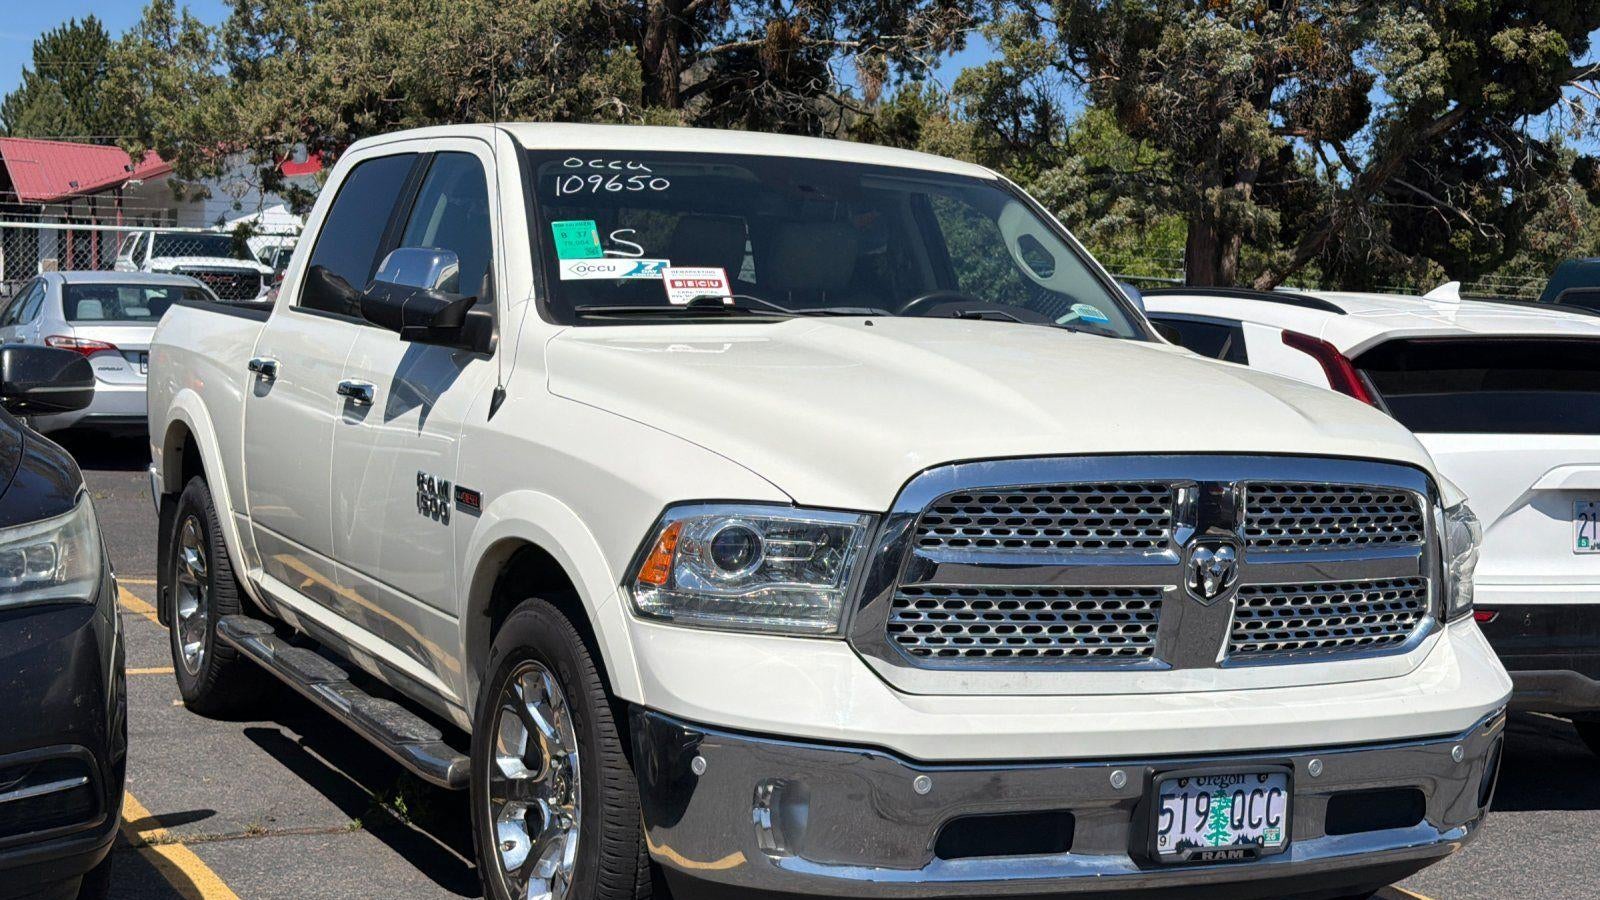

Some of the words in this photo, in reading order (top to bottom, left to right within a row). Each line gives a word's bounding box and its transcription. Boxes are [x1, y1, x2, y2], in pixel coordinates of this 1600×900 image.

[556, 174, 670, 197] 109650
[603, 228, 644, 257] S
[576, 265, 616, 273] OCCU
[417, 491, 451, 525] 1500
[1196, 774, 1246, 789] Oregon
[1201, 850, 1245, 861] RAM
